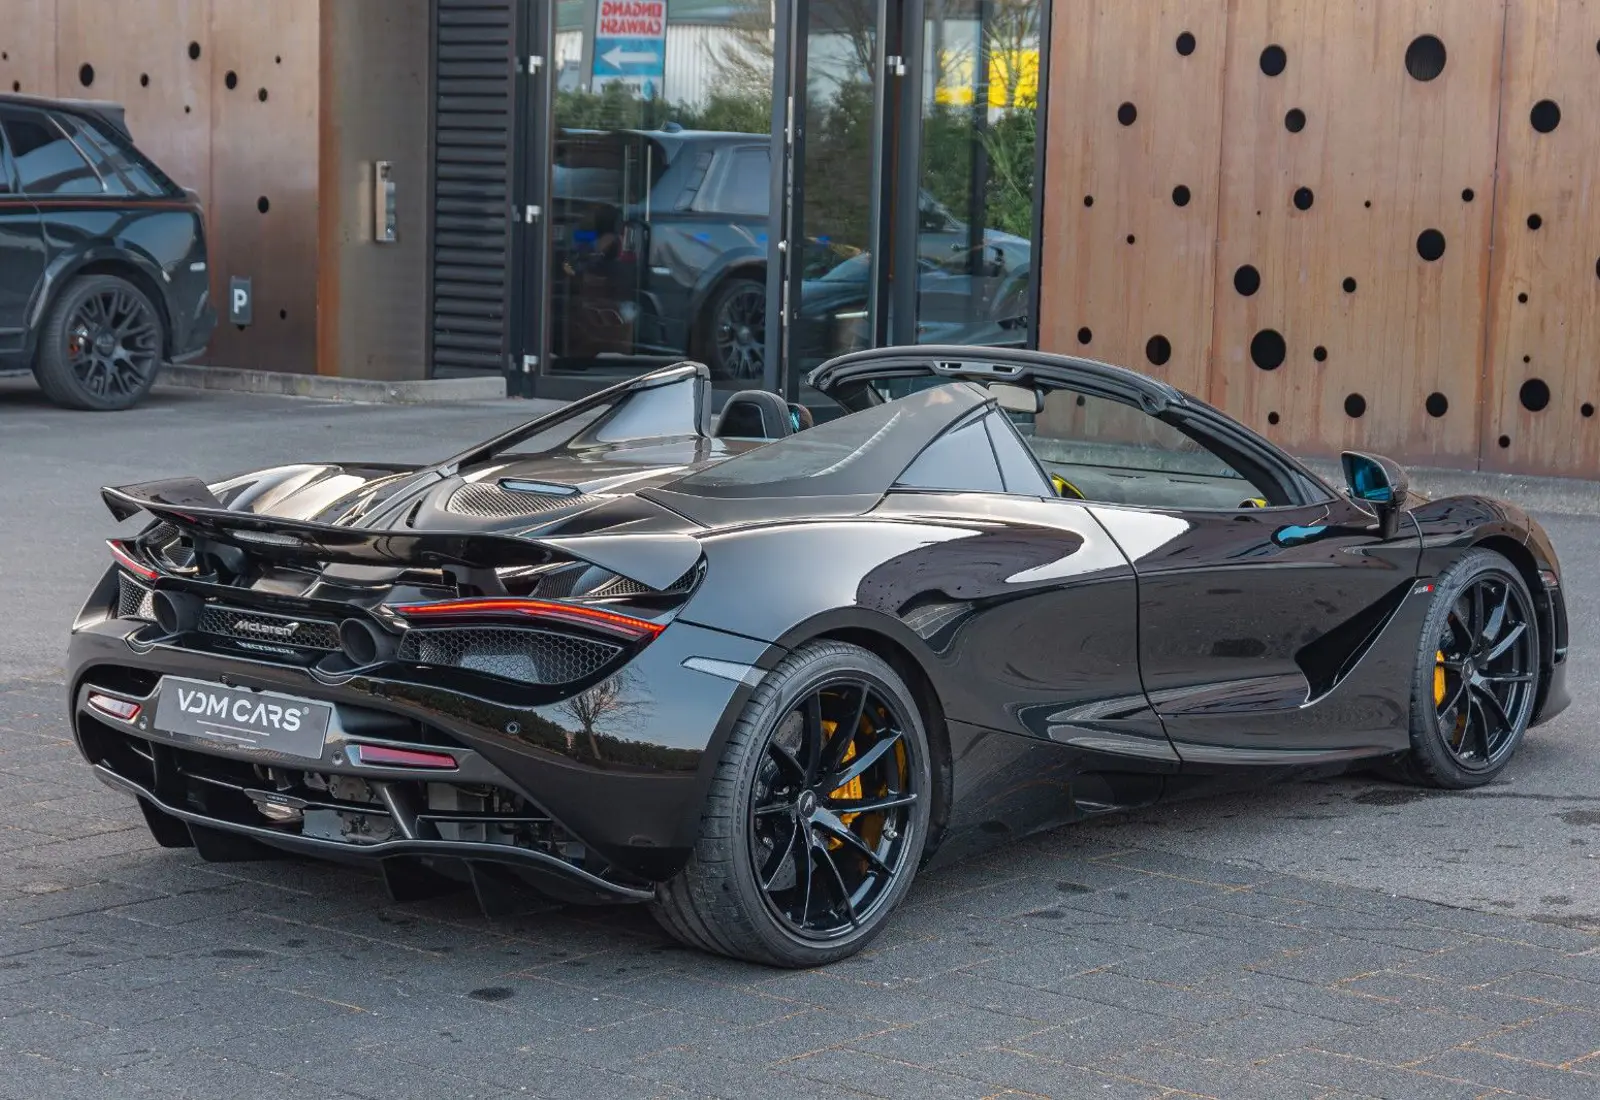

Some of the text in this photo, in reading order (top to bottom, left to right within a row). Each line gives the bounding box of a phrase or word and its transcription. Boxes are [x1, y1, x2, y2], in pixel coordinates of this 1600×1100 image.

[233, 288, 248, 314] P
[233, 620, 292, 636] McLaren
[177, 688, 229, 719] VDM
